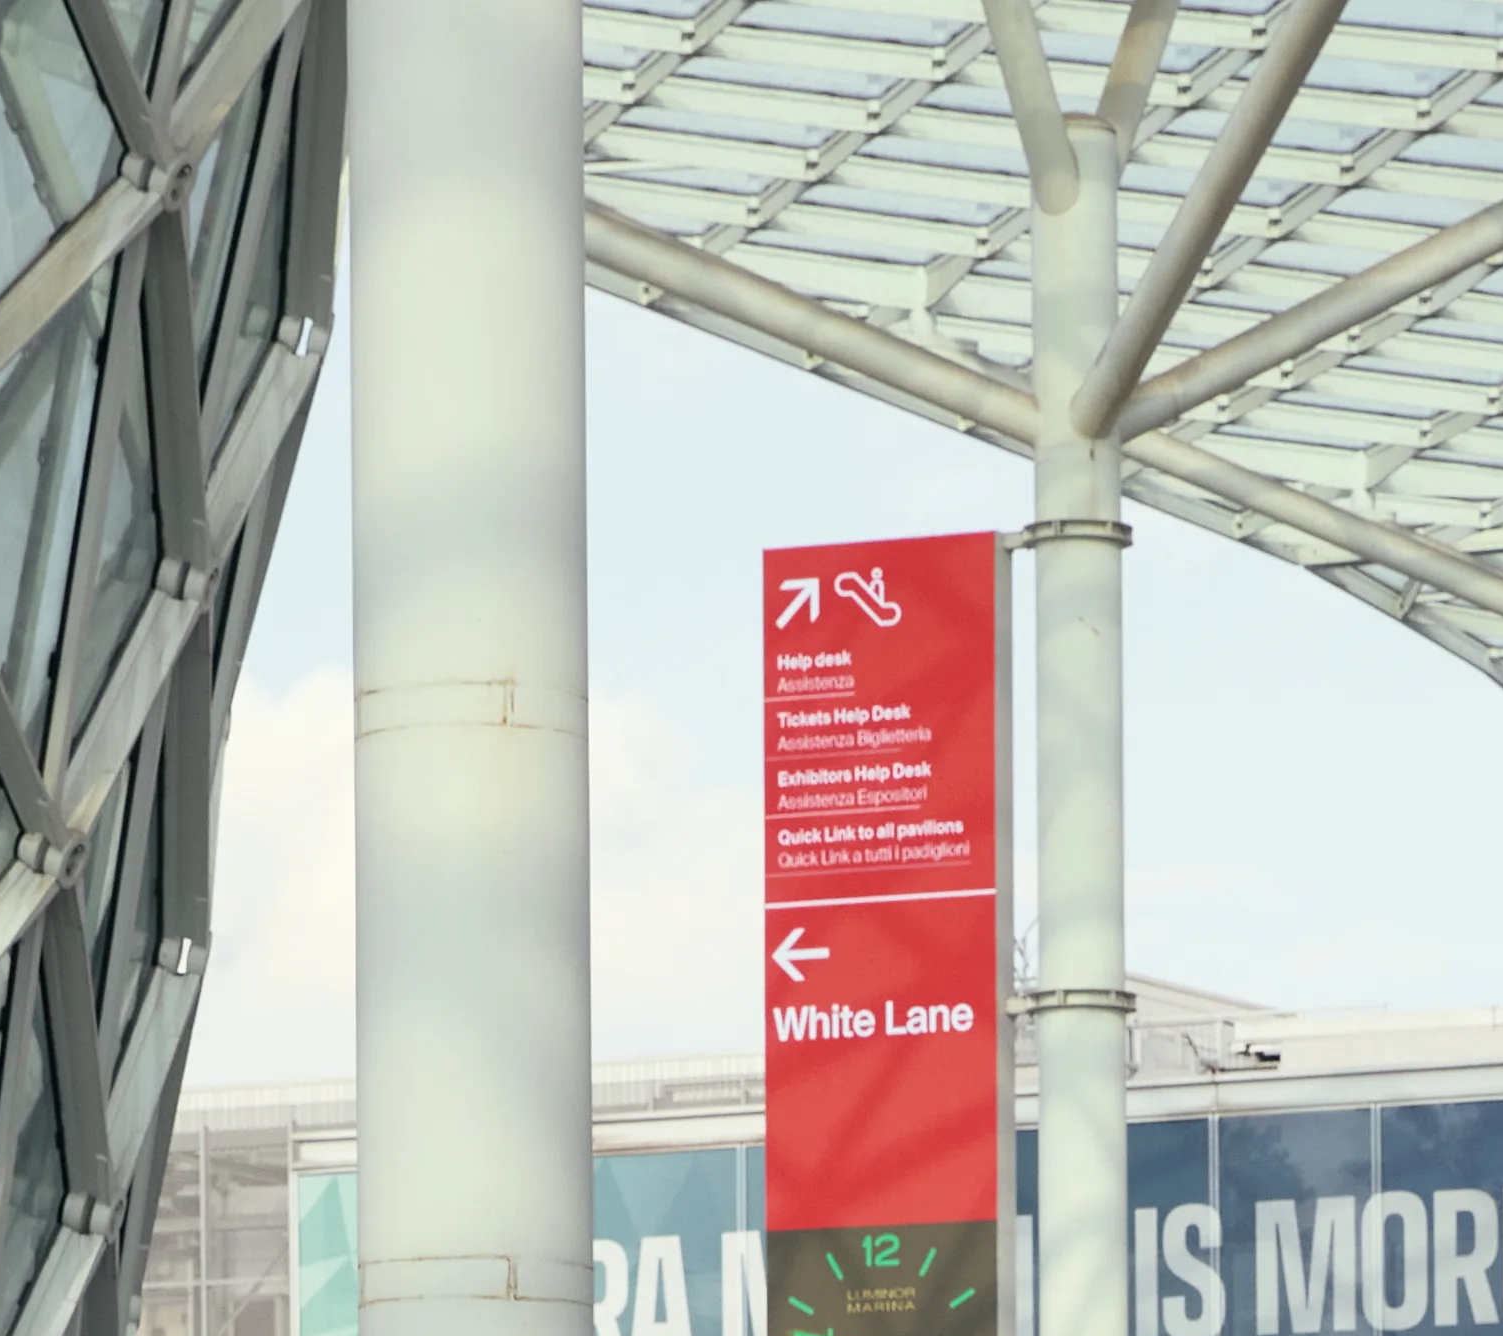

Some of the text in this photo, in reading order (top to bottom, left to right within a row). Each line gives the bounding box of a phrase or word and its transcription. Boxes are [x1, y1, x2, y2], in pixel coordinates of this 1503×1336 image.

[777, 650, 851, 673] Help desk
[778, 673, 854, 692] Assistenza
[777, 703, 910, 729] Tickets Help Desk
[778, 762, 931, 787] Exhibitors Help Desk
[778, 819, 963, 847] Quick Link to all pavilions
[778, 849, 819, 870] Quick
[821, 849, 851, 867] Link
[853, 853, 862, 864] a
[865, 846, 892, 863] tutti
[902, 841, 969, 865] padiglioni
[773, 1000, 973, 1042] White Lane
[862, 1235, 900, 1268] 12
[846, 1288, 916, 1302] LUMINOR
[846, 1302, 916, 1313] MARINA
